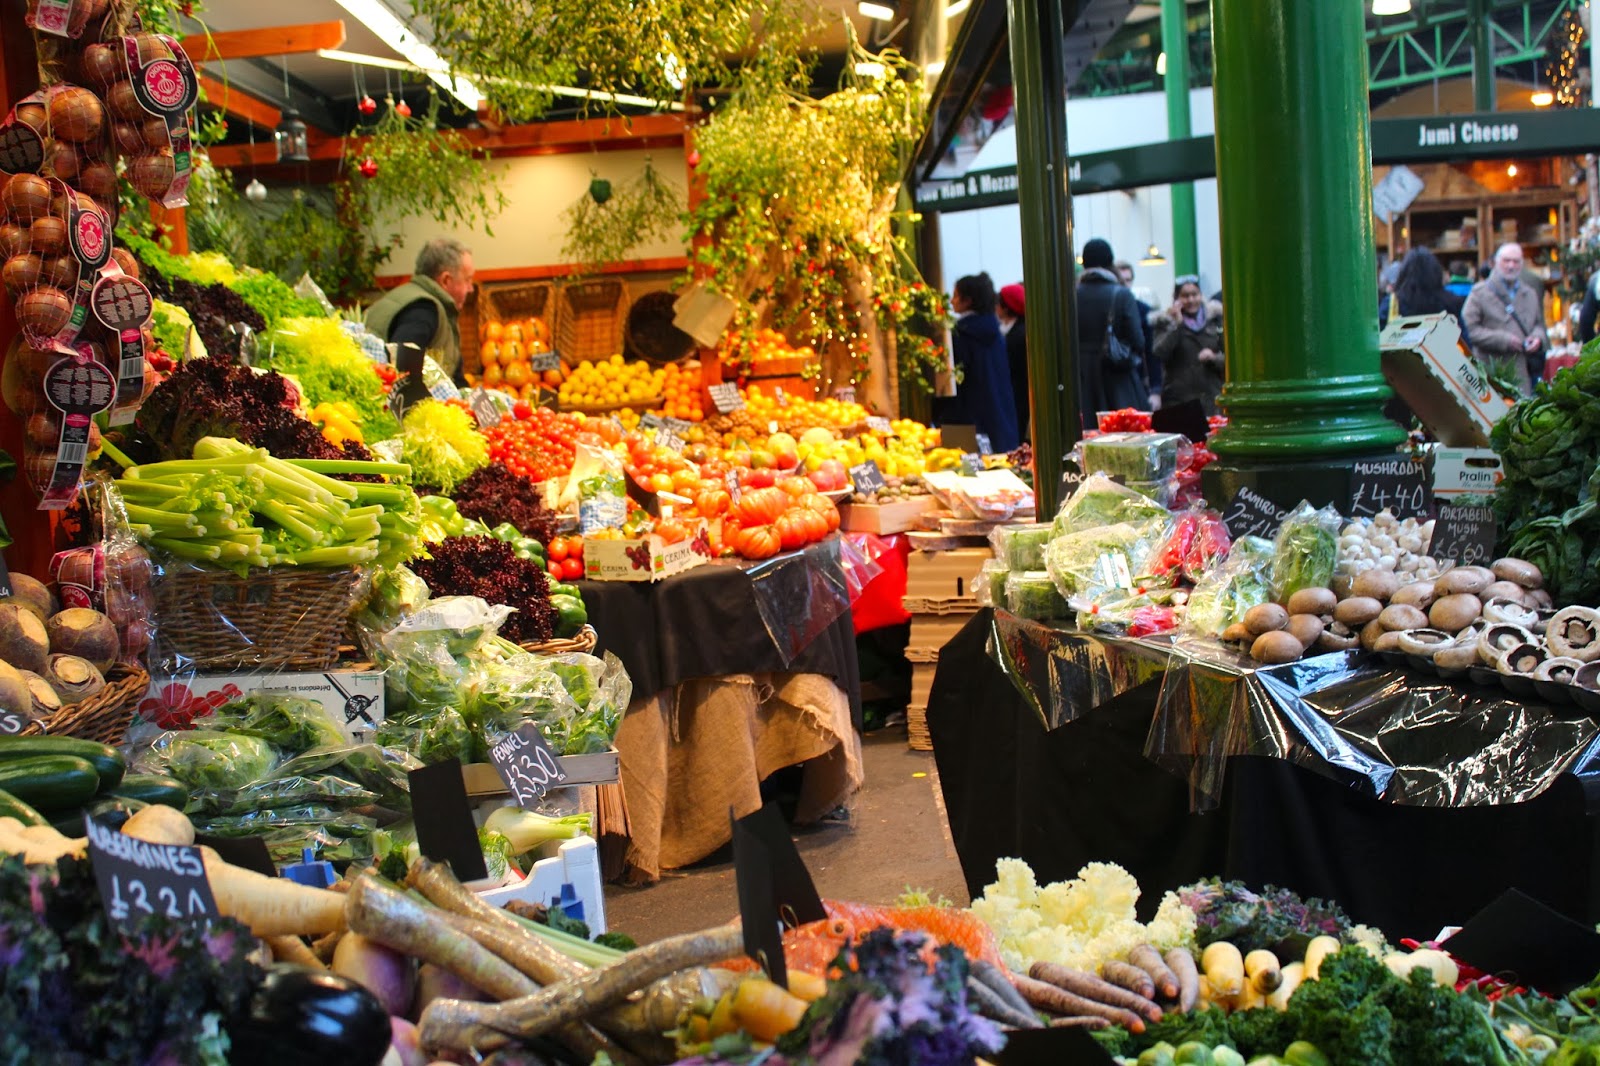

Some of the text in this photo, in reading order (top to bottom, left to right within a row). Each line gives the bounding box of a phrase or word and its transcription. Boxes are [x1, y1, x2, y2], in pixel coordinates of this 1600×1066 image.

[1418, 121, 1519, 146] Jumi Cheese
[968, 176, 978, 196] &
[980, 174, 1018, 194] Mozza
[1459, 363, 1483, 393] Pralin
[1354, 461, 1426, 481] MUSHROOM
[1459, 471, 1491, 481] Pralin
[1447, 522, 1479, 538] MUSH
[664, 547, 691, 565] CERIMA
[300, 684, 331, 692] Défendons
[492, 732, 530, 764] FENNEL
